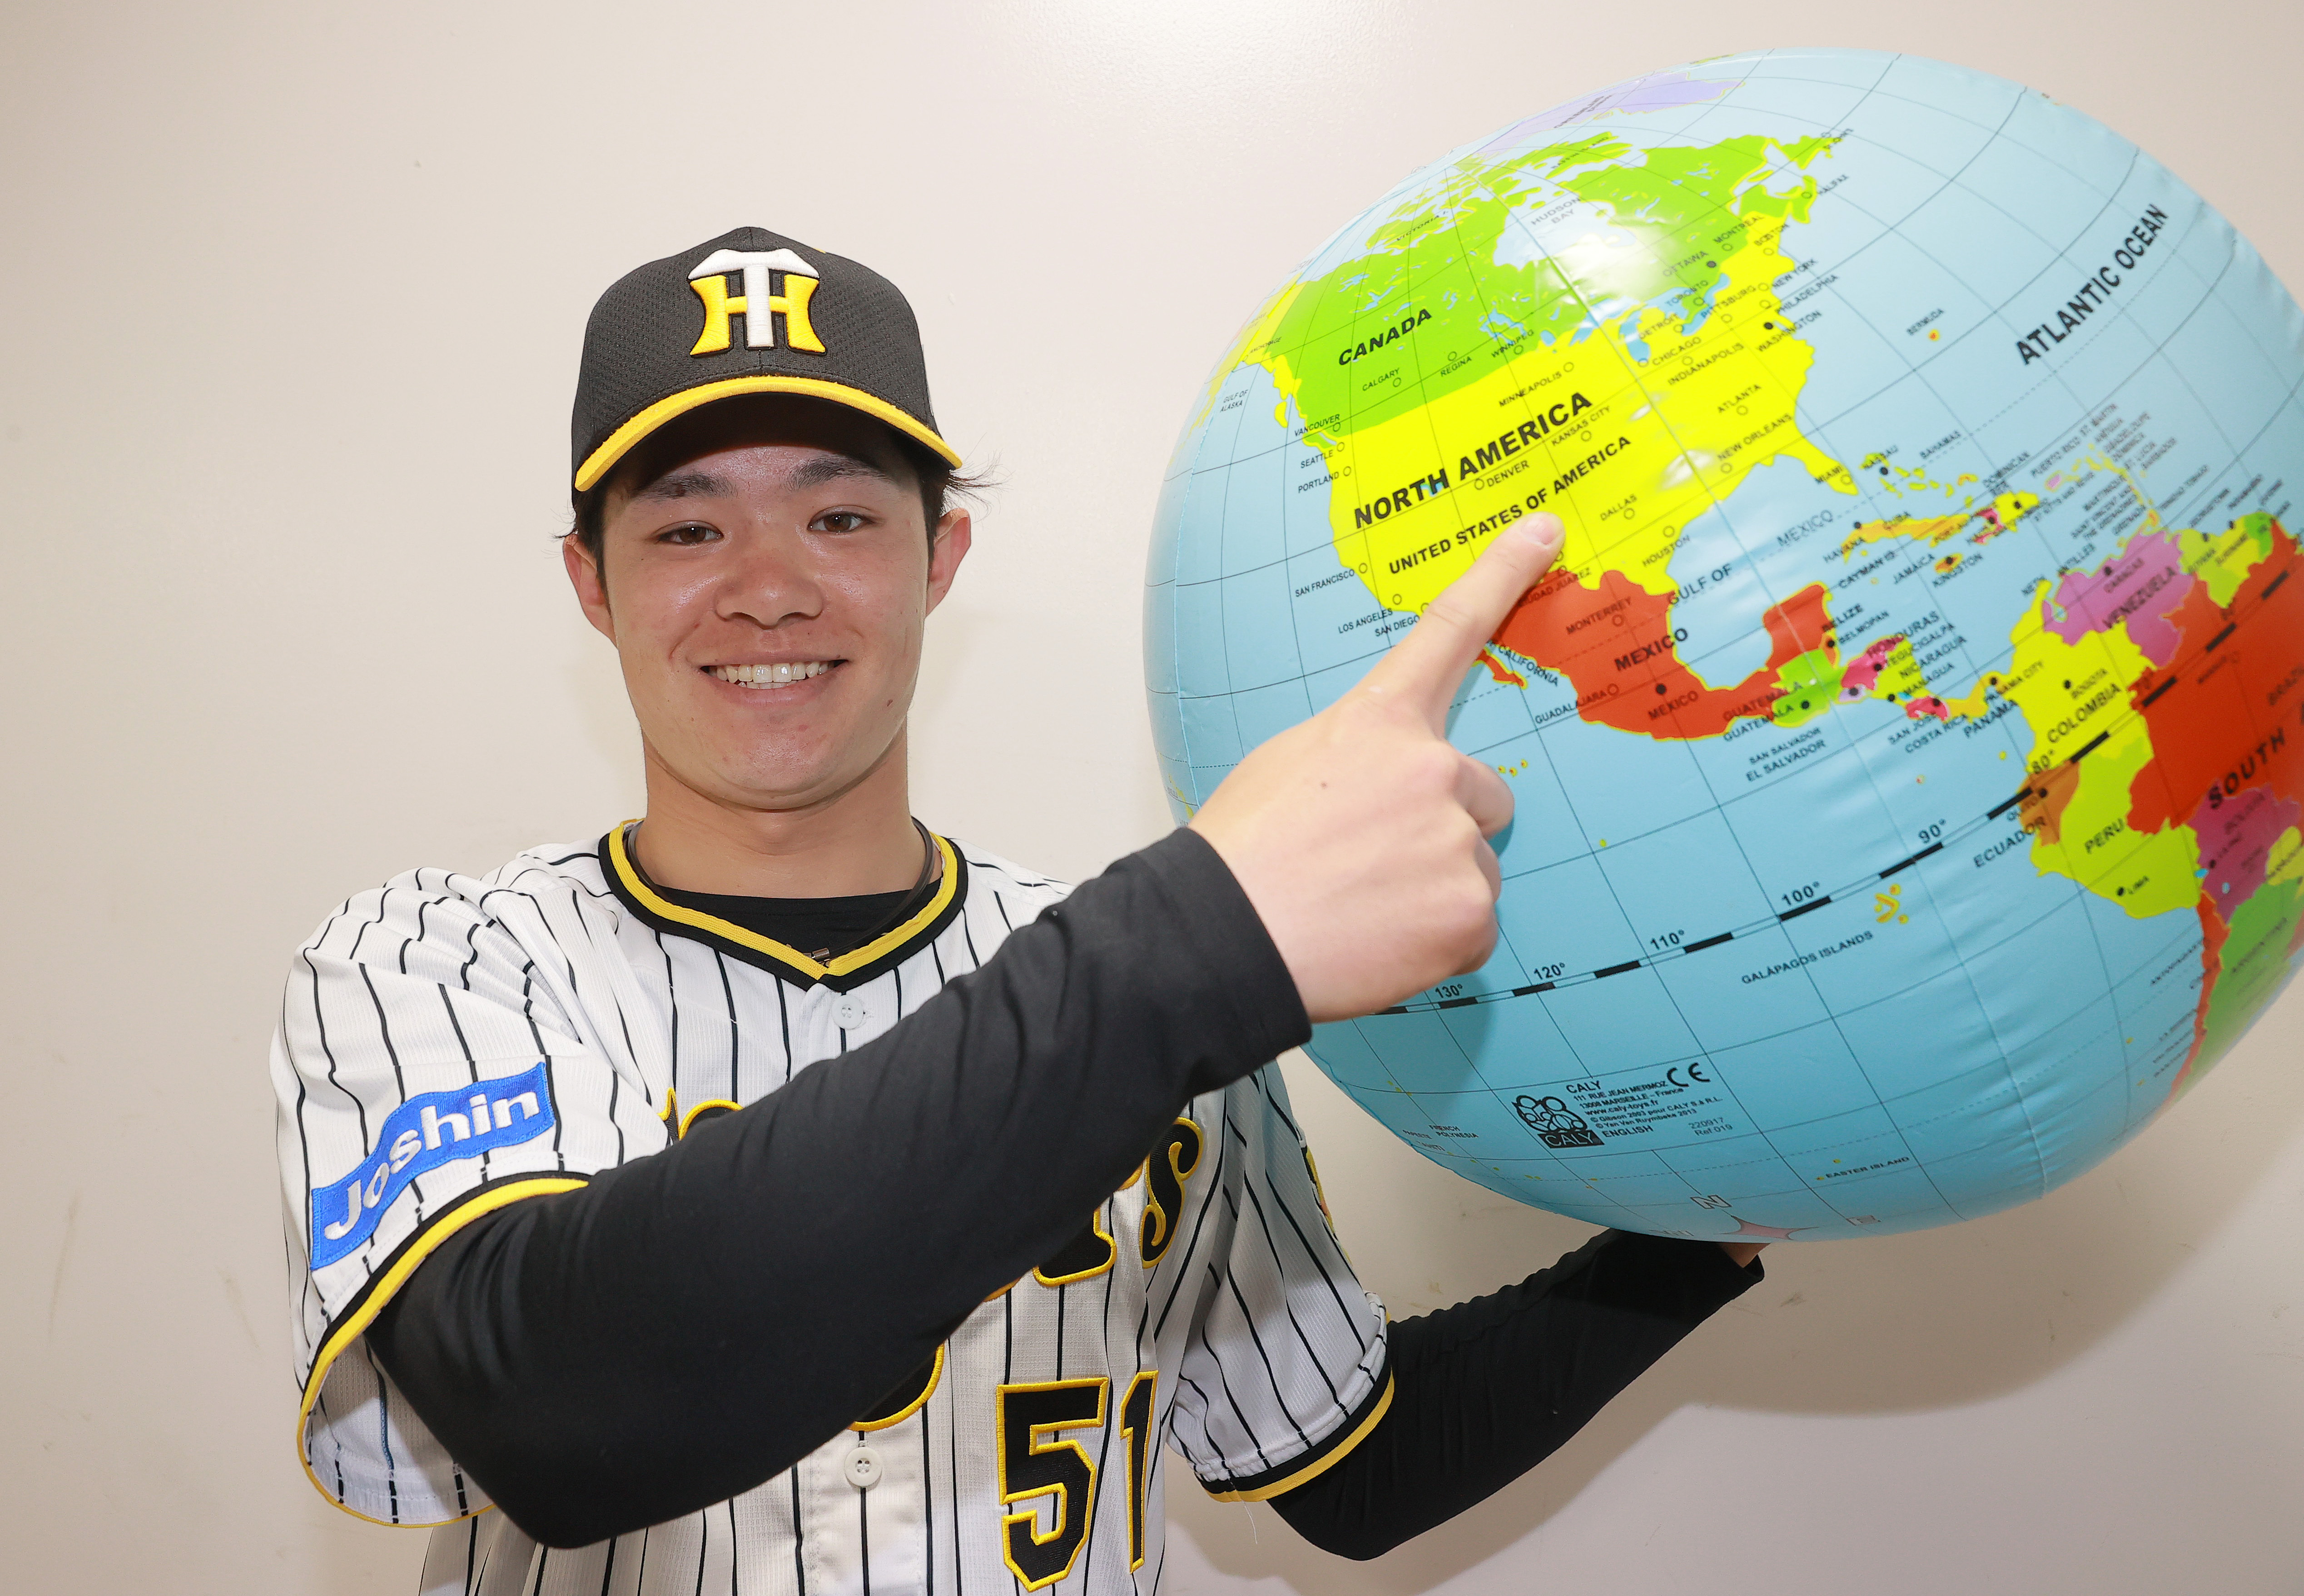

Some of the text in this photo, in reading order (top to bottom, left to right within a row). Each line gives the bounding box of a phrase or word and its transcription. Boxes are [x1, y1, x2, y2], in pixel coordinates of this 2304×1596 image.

[1818, 174, 1849, 195] HALIFAX
[1530, 197, 1581, 225] HUDSON
[1551, 209, 1575, 224] BAY
[1396, 214, 1440, 241] VICTORIA
[1713, 215, 1764, 244] MONTREAL
[1754, 224, 1790, 246] BOSTON
[1662, 251, 1708, 277] OTTAWA
[1773, 259, 1818, 289] NEW YORK
[1667, 280, 1708, 307] TORONTO
[2016, 203, 2169, 365] ATLANTIC OCEAN
[1338, 308, 1432, 366] CANADA
[1639, 313, 1679, 340] DETROIT
[1758, 311, 1822, 352] WASHINGTON
[1491, 329, 1534, 358] WINNIPEG
[1652, 337, 1701, 366] CHICAGO
[1440, 355, 1472, 378] REGINA
[1668, 343, 1745, 385] INDIANAPOLIS
[1362, 368, 1400, 391] CALGARY
[1499, 371, 1562, 407] MINNEAPOLIS
[1220, 400, 1243, 413] ALASKA
[1223, 389, 1249, 403] GULF OF
[1718, 384, 1762, 413] ATLANTA
[1295, 414, 1340, 437] VANCOUVER
[1551, 406, 1610, 447] KANSAS CITY
[1718, 413, 1792, 461] NEW ORLEANS
[1301, 450, 1333, 468] SEATTLE
[1920, 430, 1962, 459] BAHAMAS
[1354, 392, 1593, 529] NORTH AMERICA
[1487, 460, 1529, 487] DENVER
[1815, 465, 1843, 484] MIAMI
[1298, 472, 1339, 493] PORTLAND
[1389, 437, 1631, 574] UNITED STATES OF AMERICA
[1600, 494, 1638, 521] DALLAS
[1642, 535, 1691, 567] HOUSTON
[1668, 509, 1833, 605] GULF OF MEXICO
[1295, 569, 1355, 597] SAN FRANCISCO
[1338, 608, 1393, 634] LOS ANGELES
[1375, 615, 1420, 637] SAN DIEGO
[1566, 597, 1632, 635] MONTERREY
[1866, 611, 1940, 658] HONDURAS
[1614, 628, 1688, 671] MEXICO
[1899, 635, 1967, 679] NICARAGUA
[1499, 646, 1559, 686] CALIFORNIA
[1904, 662, 1955, 694] MANAGUA
[1535, 690, 1606, 724] GUADALAJARA
[1648, 691, 1698, 720] MEXICO
[1722, 681, 1803, 721] GUATEMALA
[2047, 682, 2122, 743] COLOMBIA
[1723, 705, 1794, 742] GUATEMALA
[1905, 713, 1969, 753] COSTA RICA
[1963, 699, 2019, 738] PANAMA
[1749, 727, 1821, 765] SAN SALVADOR
[1887, 728, 1911, 745] SAN
[1746, 739, 1826, 782] EL SALVADOR
[2209, 727, 2285, 809] SOUTH
[1918, 818, 1947, 844] 90°
[1973, 815, 2047, 868] ECUADOR
[2084, 816, 2125, 855] PERU
[1781, 880, 1820, 906] 100°
[1650, 929, 1685, 952] 110°
[1819, 930, 1874, 959] ISLANDS
[1533, 962, 1566, 981] 120°
[1434, 983, 1465, 999] 130°
[1566, 1080, 1602, 1094] CALY
[1589, 1091, 1607, 1099] RUE
[1608, 1088, 1630, 1097] JEAN
[1629, 1081, 1668, 1093] MERMOZ
[1601, 1093, 1649, 1106] MARSEILLE
[1655, 1088, 1684, 1097] France
[1585, 1099, 1659, 1116] www.caly-toys.fr
[1667, 1102, 1689, 1111] CALY
[1544, 1131, 1595, 1147] CALY
[1602, 1124, 1654, 1138] ENGLISH
[324, 1090, 541, 1241] Joshin
[1825, 1155, 1910, 1179] EASTER ISLAND
[1690, 1194, 1733, 1210] N
[996, 1369, 1161, 1594] 51
